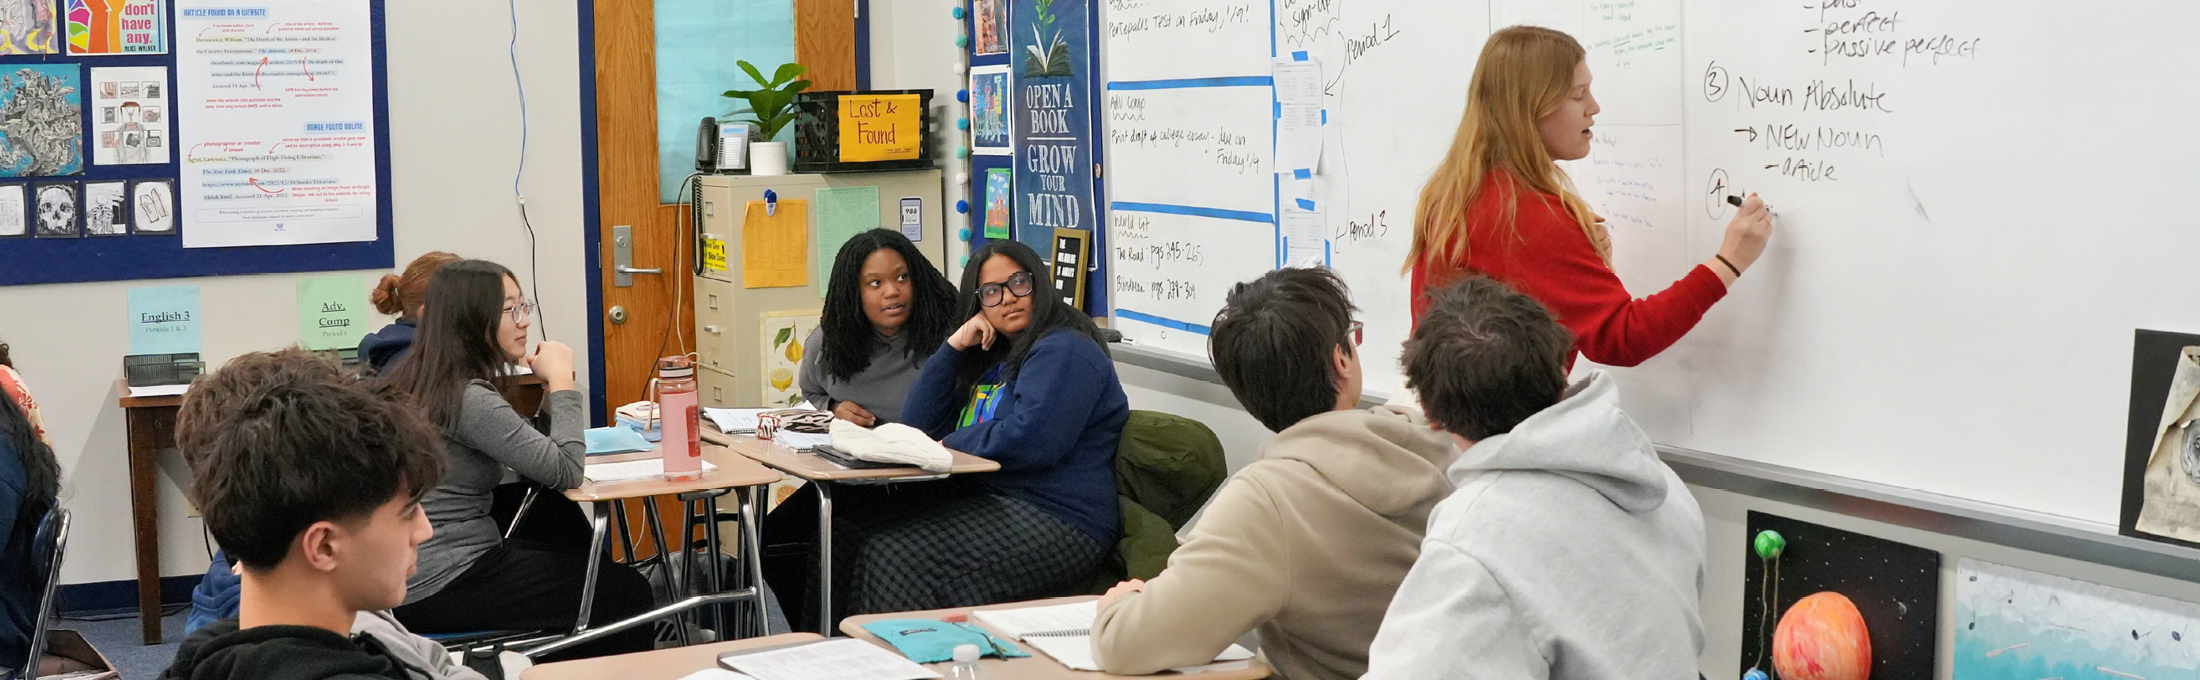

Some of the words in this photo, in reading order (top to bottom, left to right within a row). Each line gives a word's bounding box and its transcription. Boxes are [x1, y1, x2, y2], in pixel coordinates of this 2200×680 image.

[125, 4, 155, 15] don't
[122, 18, 152, 30] have
[1825, 11, 1903, 38] perfect
[1347, 22, 1381, 65] Period
[1382, 14, 1400, 41] 1
[1824, 37, 1896, 66] passive
[1904, 34, 1980, 67] perfect
[1026, 84, 1061, 109] OPEN
[1064, 83, 1074, 108] A
[1737, 76, 1793, 112] Noun
[1803, 78, 1893, 113] Absolute
[850, 98, 881, 118] Lost
[886, 102, 898, 114] &
[858, 121, 896, 144] Found
[1031, 109, 1069, 134] BOOK
[1160, 128, 1184, 148] college
[1766, 124, 1810, 150] NEW
[1028, 145, 1077, 174] GROW
[1217, 148, 1245, 174] Friday
[1782, 157, 1838, 181] article
[1040, 175, 1066, 192] YOUR
[1028, 193, 1080, 228] MIND
[1350, 213, 1376, 246] Period
[1380, 210, 1388, 237] 3
[1116, 247, 1126, 260] The
[1151, 244, 1164, 271] pgs
[1152, 281, 1164, 301] pgs
[141, 312, 182, 323] English
[184, 311, 191, 320] 3
[322, 302, 346, 311] Adv.
[319, 318, 350, 327] Comp
